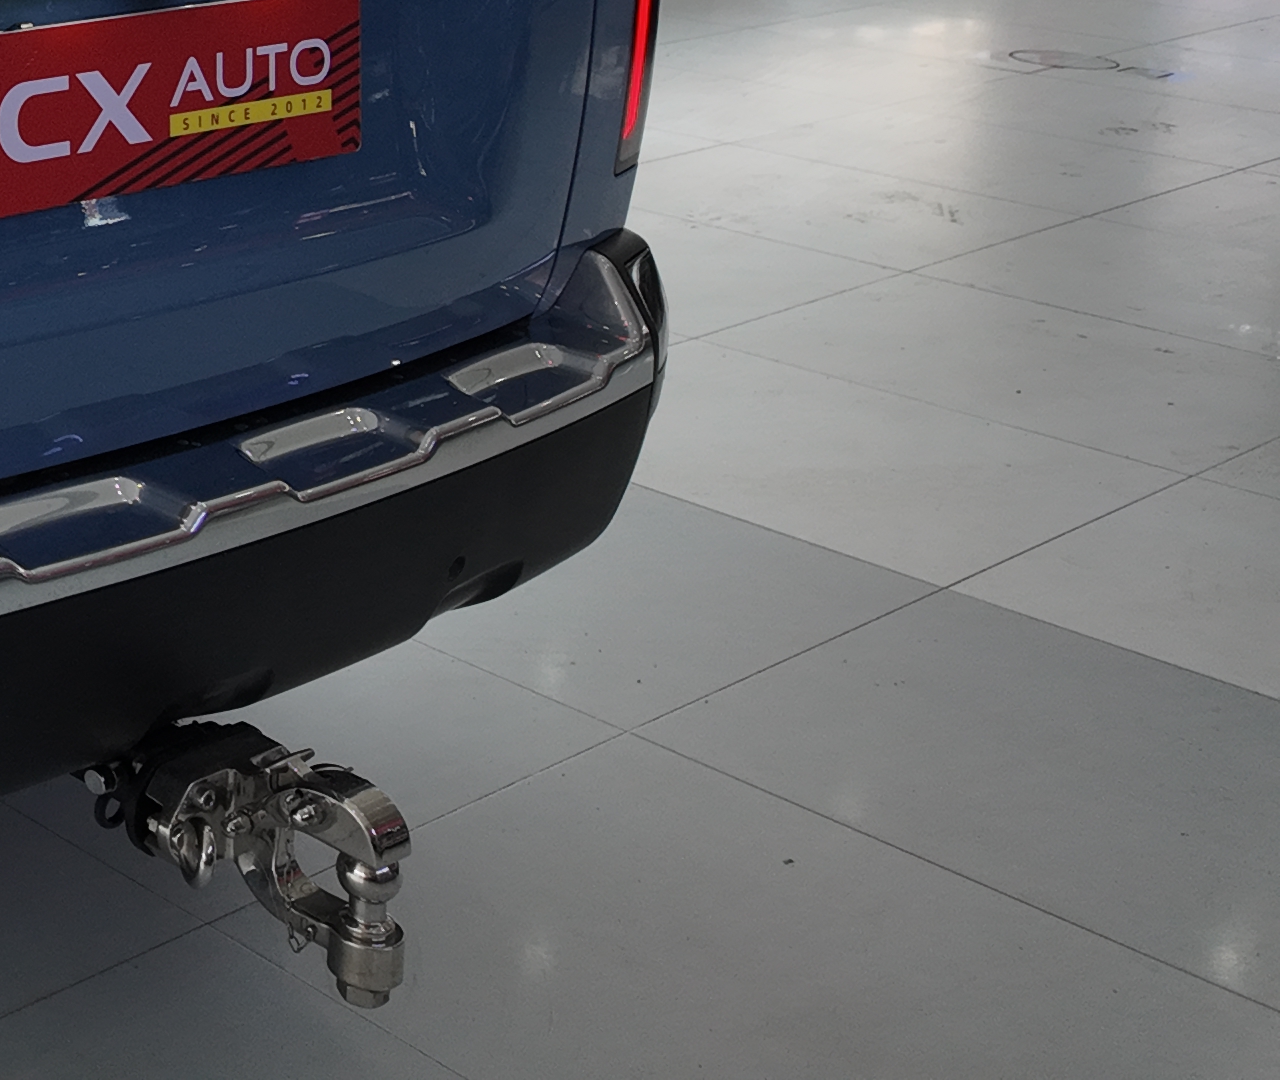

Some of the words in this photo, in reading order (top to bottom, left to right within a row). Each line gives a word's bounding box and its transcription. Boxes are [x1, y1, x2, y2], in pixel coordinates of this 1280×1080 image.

[170, 38, 332, 108] AUTO
[182, 106, 251, 132] SINCE
[270, 95, 324, 117] 2012
